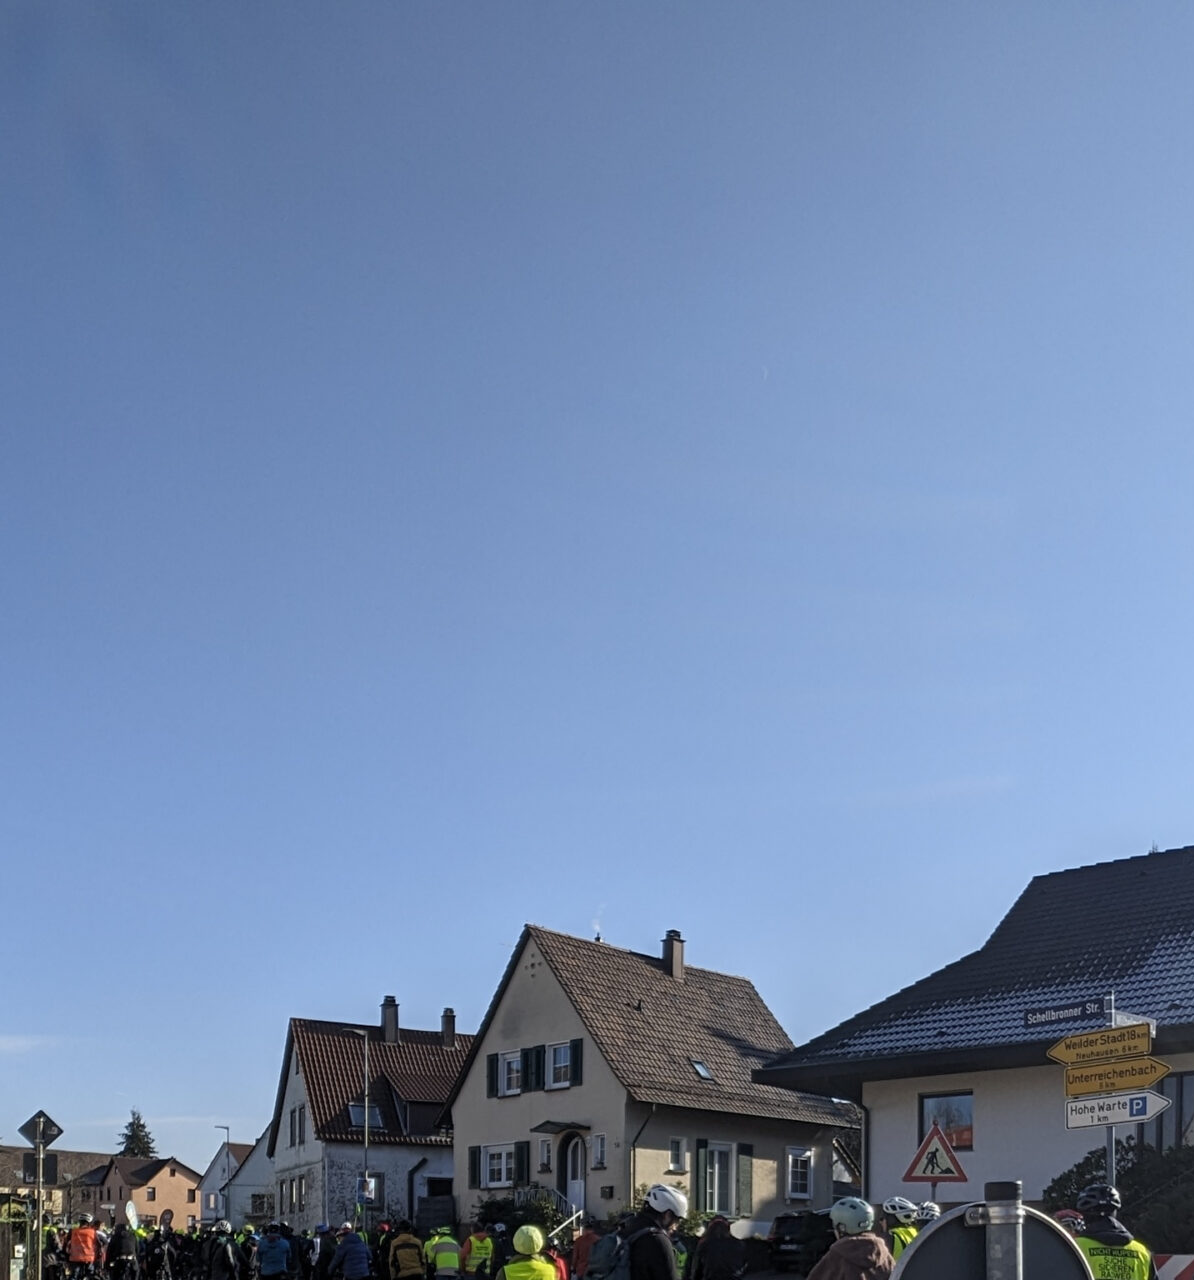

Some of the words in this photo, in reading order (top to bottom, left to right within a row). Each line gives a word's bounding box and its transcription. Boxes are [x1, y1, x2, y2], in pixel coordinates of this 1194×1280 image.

[1027, 1006, 1083, 1025] Schellbronner
[1085, 1002, 1100, 1014] Str.
[1064, 1037, 1083, 1050] Weil
[1083, 1035, 1100, 1048] der
[1100, 1031, 1126, 1045] Stadt
[1126, 1029, 1136, 1041] 18
[1076, 1048, 1119, 1060] Neuhausen
[1128, 1044, 1139, 1052] km
[1067, 1063, 1157, 1084] Unterreichenbach
[1070, 1104, 1096, 1116] Hohe
[1097, 1100, 1128, 1112] Warte
[1132, 1099, 1143, 1115] P
[1090, 1115, 1094, 1124] 1
[1097, 1115, 1109, 1123] km
